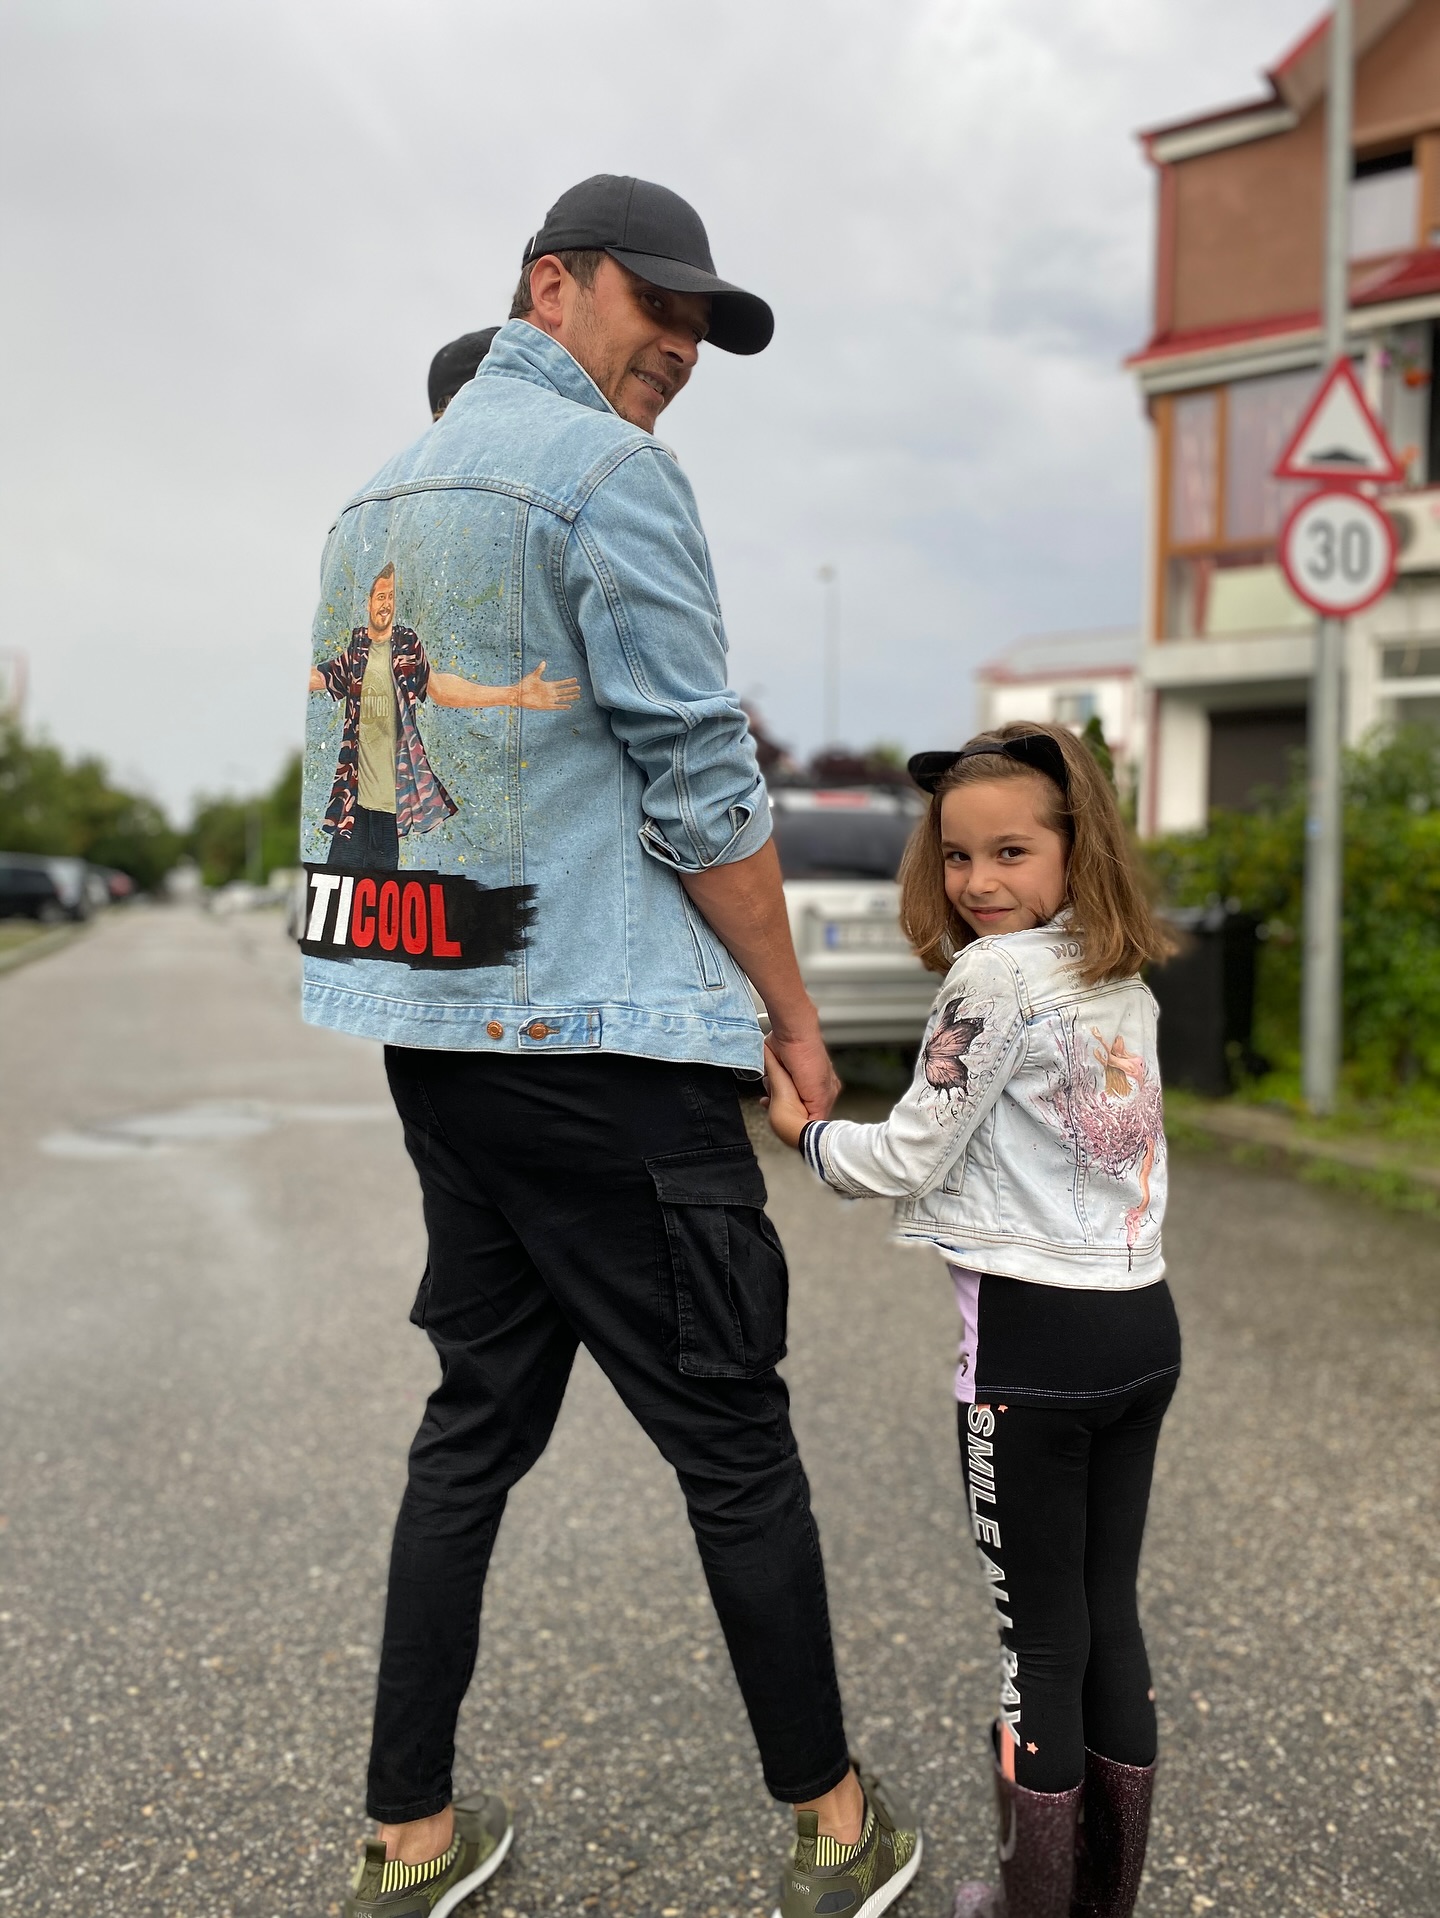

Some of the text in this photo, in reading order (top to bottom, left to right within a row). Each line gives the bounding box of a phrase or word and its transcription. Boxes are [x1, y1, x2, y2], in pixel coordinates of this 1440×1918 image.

[1306, 520, 1371, 582] 30
[306, 873, 462, 957] TICOOL
[967, 1403, 1002, 1549] SMILE
